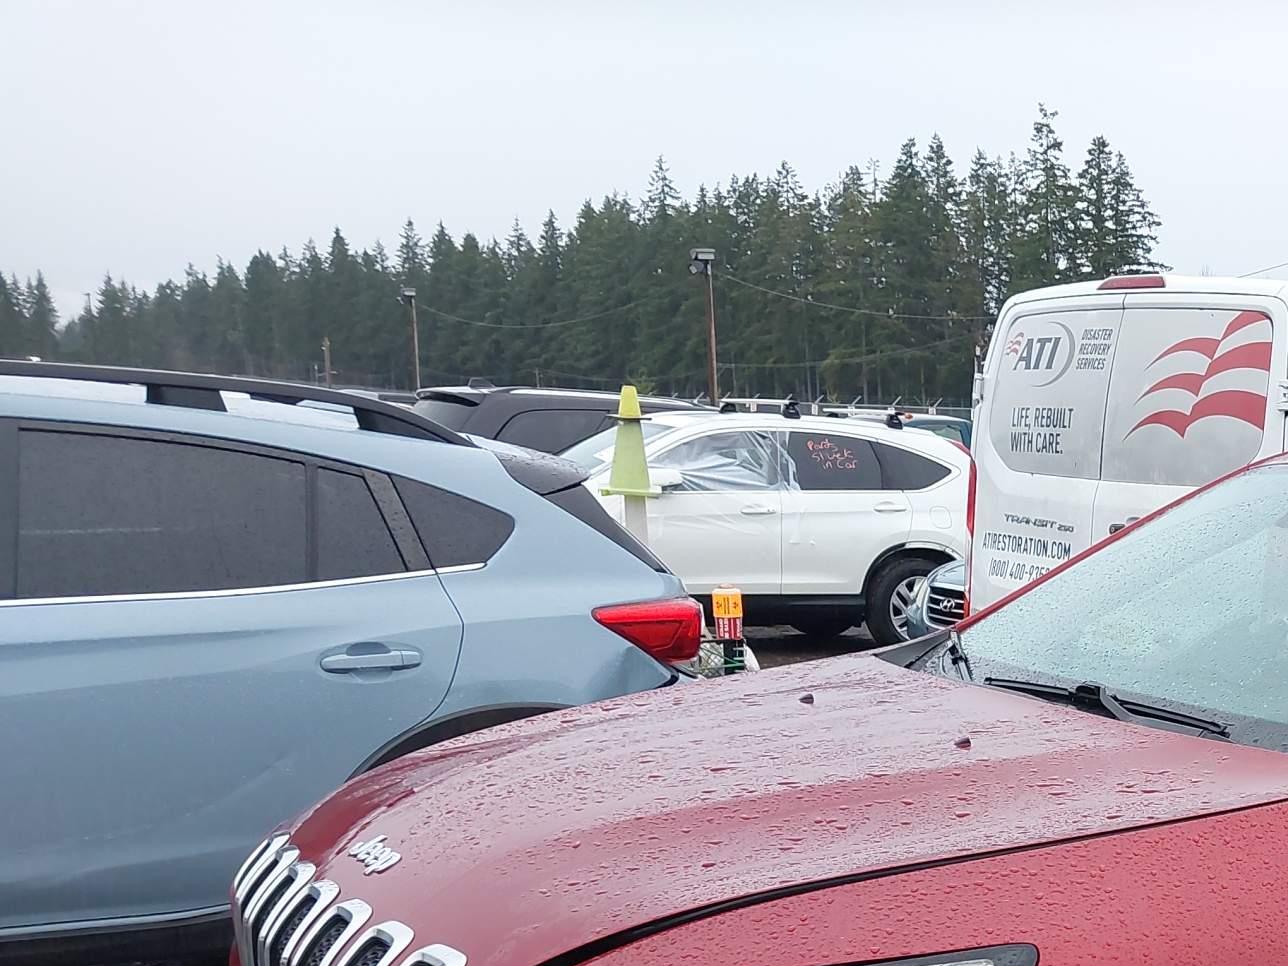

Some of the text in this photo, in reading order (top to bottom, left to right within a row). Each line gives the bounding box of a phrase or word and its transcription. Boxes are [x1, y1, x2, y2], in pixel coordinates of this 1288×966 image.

[1081, 328, 1114, 341] DISASTER
[1012, 336, 1062, 371] ATI
[1078, 343, 1112, 355] RECOVERY
[1075, 358, 1106, 370] SERVICES
[1012, 407, 1074, 430] LIFE, REBUILT
[1010, 431, 1063, 455] WITH CARE.
[822, 461, 833, 469] in
[982, 531, 1071, 561] ATIRESTORATION.COM
[988, 557, 1010, 580] (800)
[348, 834, 402, 876] Jeep
